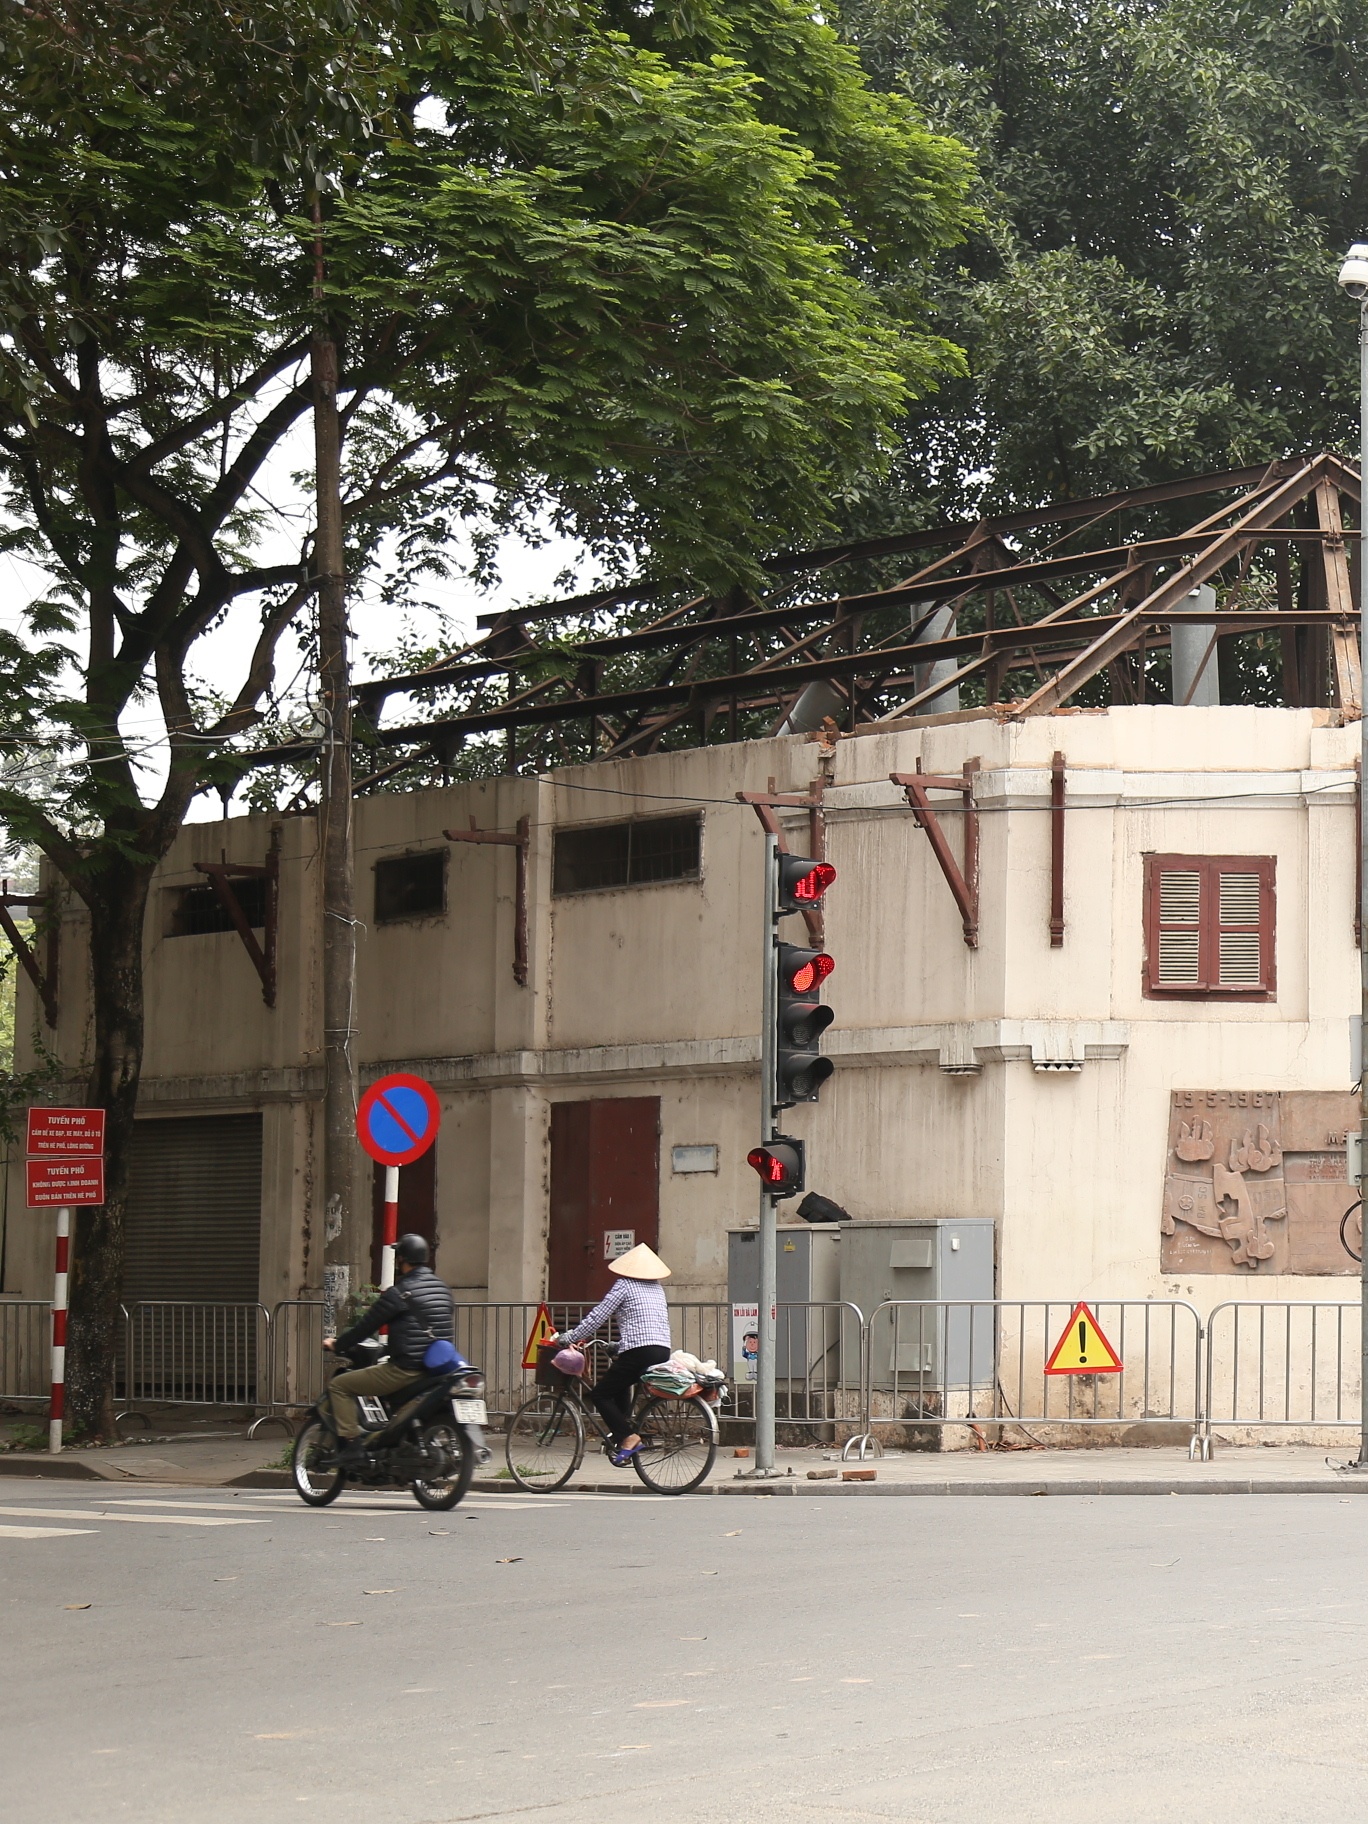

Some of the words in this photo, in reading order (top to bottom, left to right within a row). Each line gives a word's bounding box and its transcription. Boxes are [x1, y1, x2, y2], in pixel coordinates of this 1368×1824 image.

[48, 1115, 70, 1125] TUYẾN
[71, 1115, 86, 1125] PHỐ
[47, 1165, 69, 1175] TUYẾN
[70, 1164, 85, 1174] PHỐ
